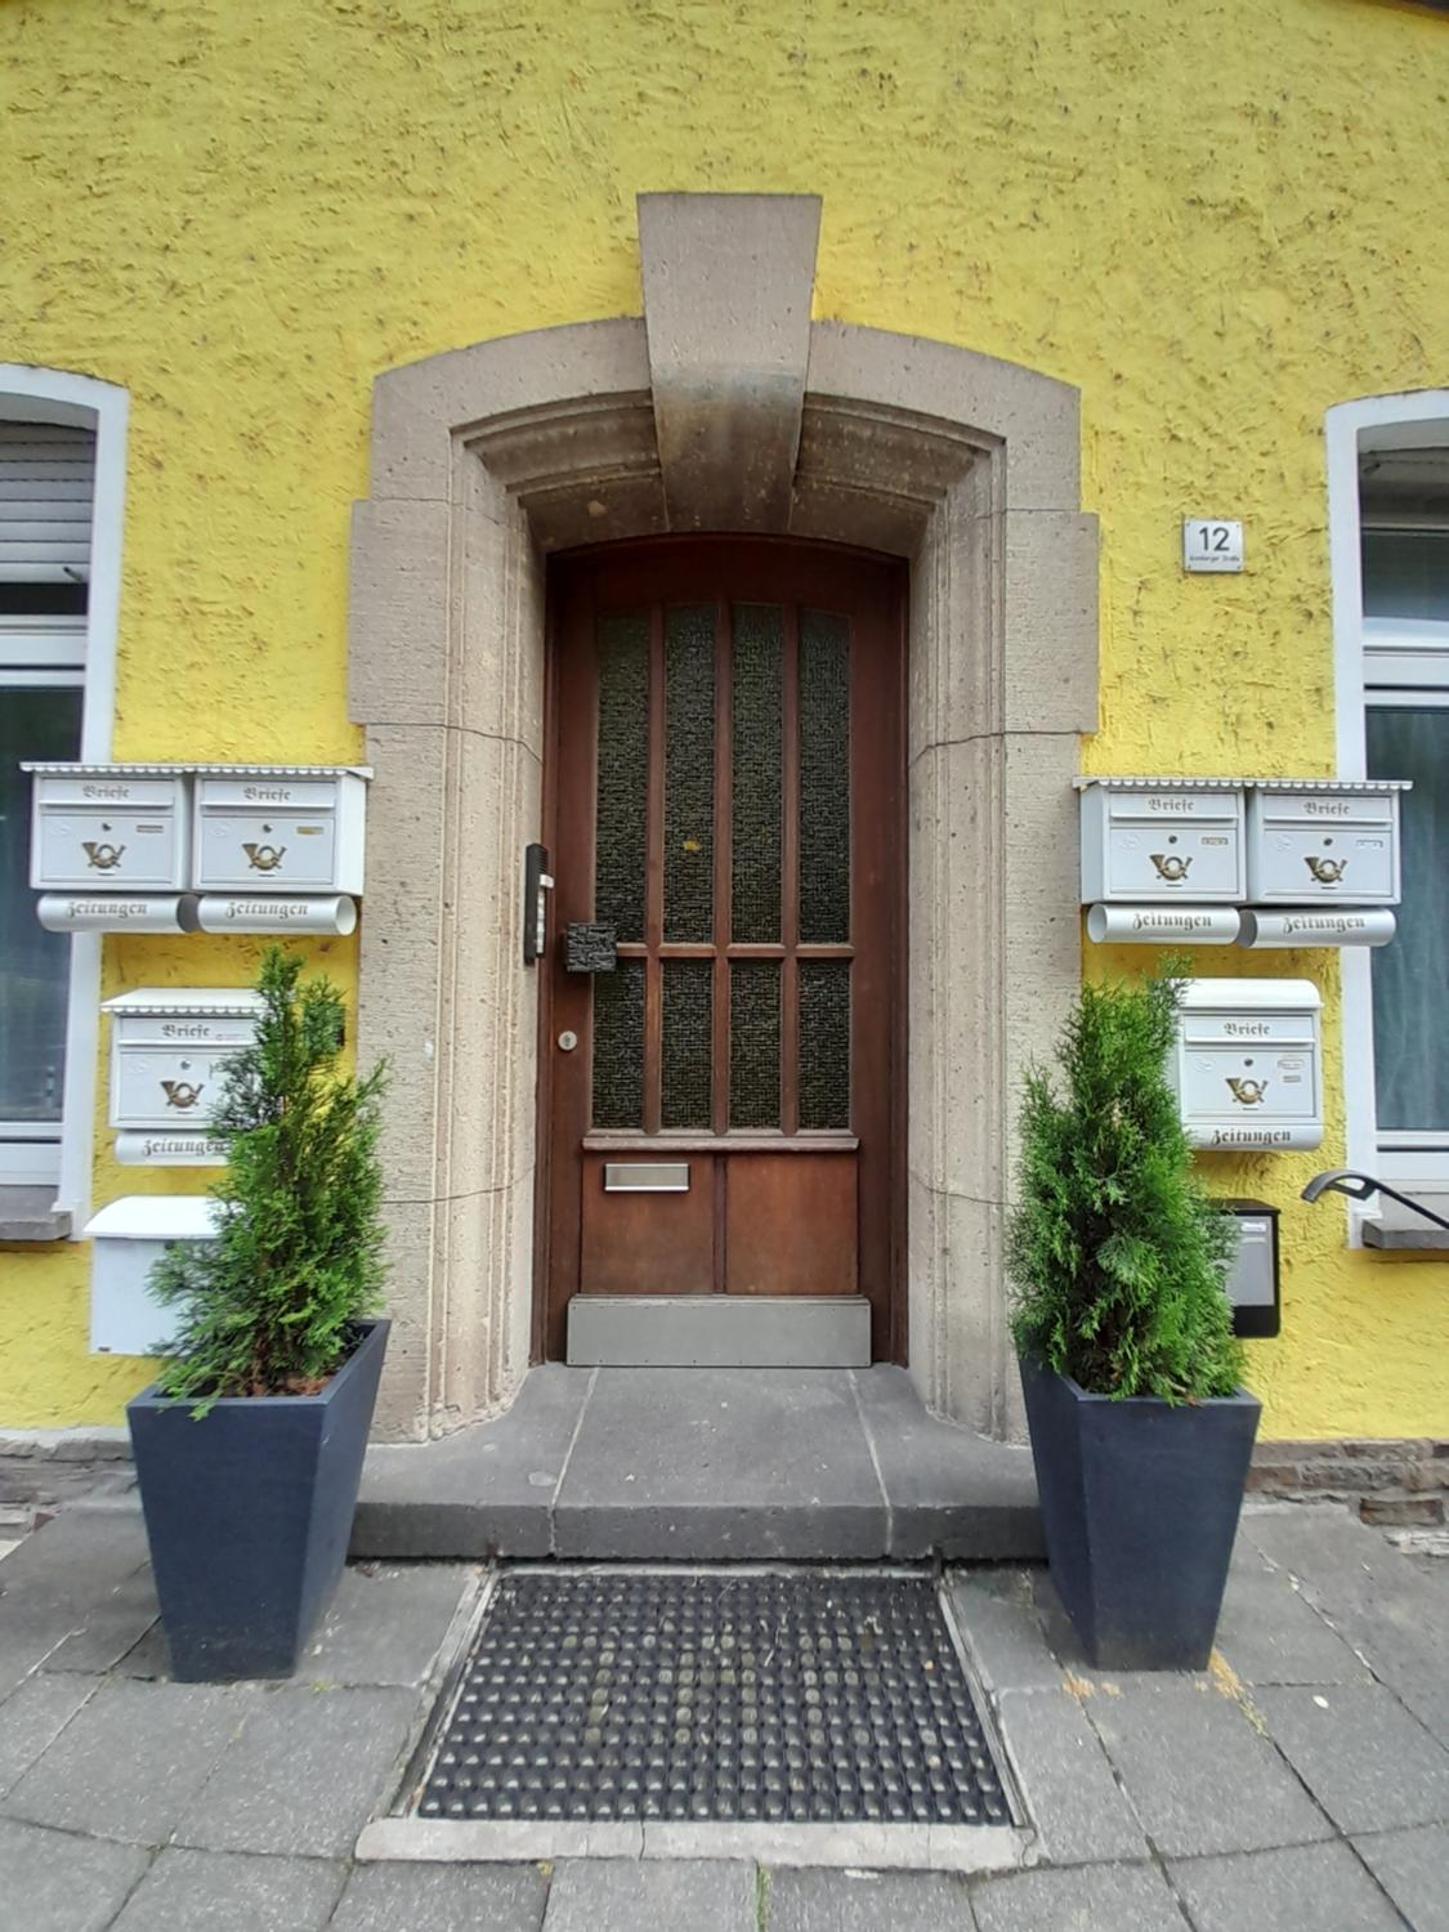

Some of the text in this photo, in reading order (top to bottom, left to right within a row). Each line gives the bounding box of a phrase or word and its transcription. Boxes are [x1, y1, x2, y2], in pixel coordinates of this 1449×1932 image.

[1199, 527, 1230, 551] 12
[82, 785, 130, 799] Briefe
[243, 787, 291, 801] Briefe
[1148, 799, 1194, 812] Briefe
[1303, 803, 1349, 816] Briefe
[67, 901, 147, 918] Zeitungen
[225, 902, 308, 918] Zeitungen
[1132, 914, 1212, 931] Zeitungen
[1283, 915, 1365, 933] Zeitungen
[162, 1024, 210, 1038] Briefe
[1223, 1023, 1270, 1036] Briefe
[1211, 1129, 1291, 1145] Zeitungen
